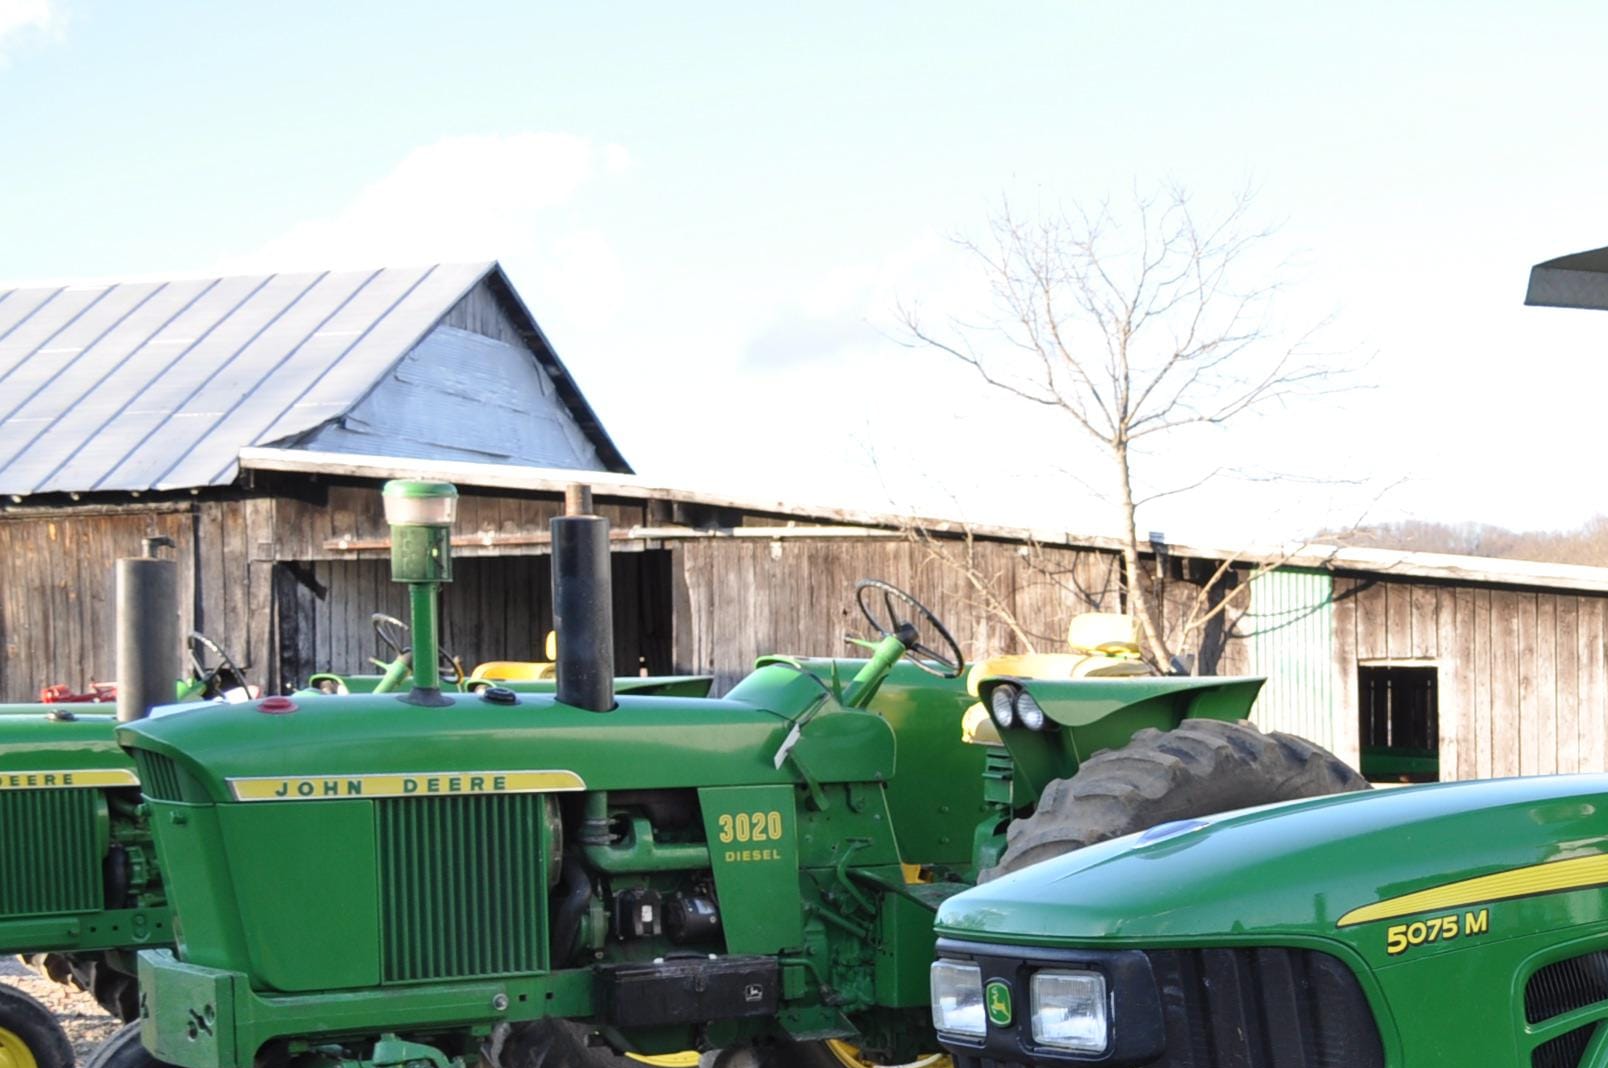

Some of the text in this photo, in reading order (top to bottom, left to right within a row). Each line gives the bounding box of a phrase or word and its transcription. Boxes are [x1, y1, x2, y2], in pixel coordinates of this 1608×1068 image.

[0, 774, 73, 786] EERE
[275, 776, 507, 797] JOHN DEERE
[718, 811, 783, 844] 3020
[725, 849, 781, 862] DIESEL
[1387, 908, 1490, 956] 5075 M
